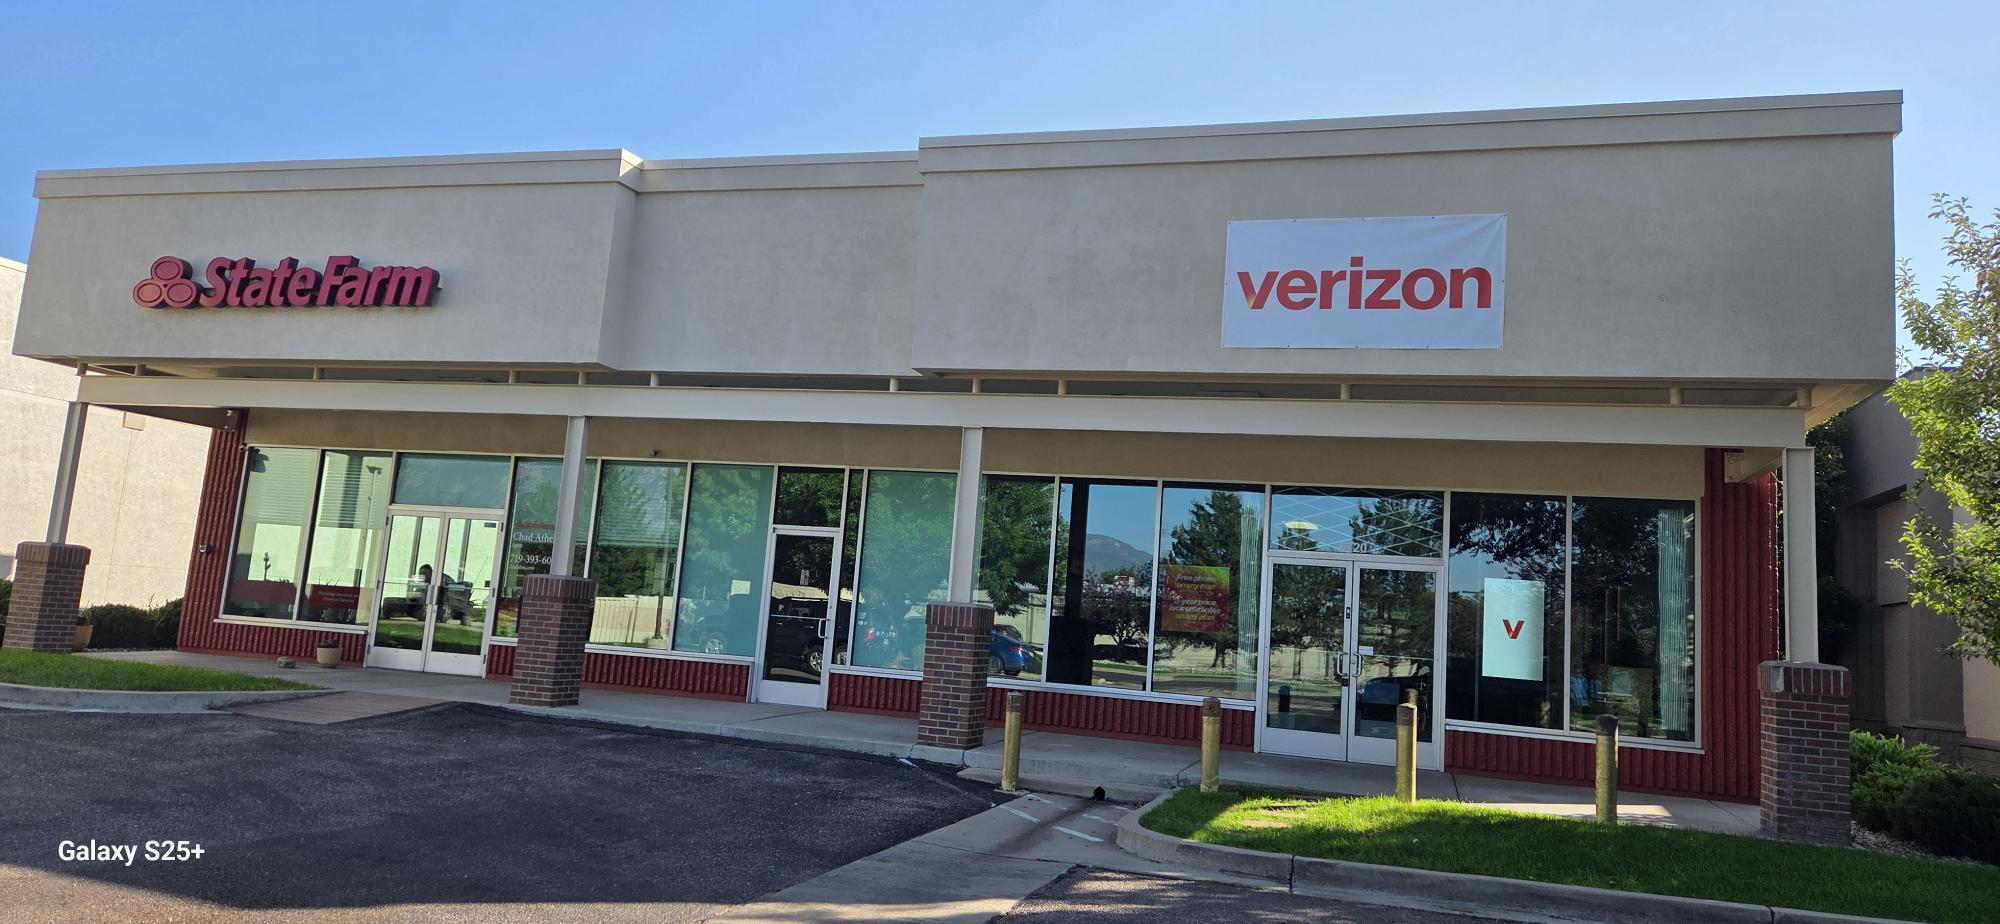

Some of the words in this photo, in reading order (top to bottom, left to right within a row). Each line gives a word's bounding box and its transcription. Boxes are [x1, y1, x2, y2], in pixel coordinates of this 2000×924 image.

[1236, 256, 1492, 310] verizon
[534, 532, 554, 543] Athe
[510, 553, 552, 565] 719-393-60
